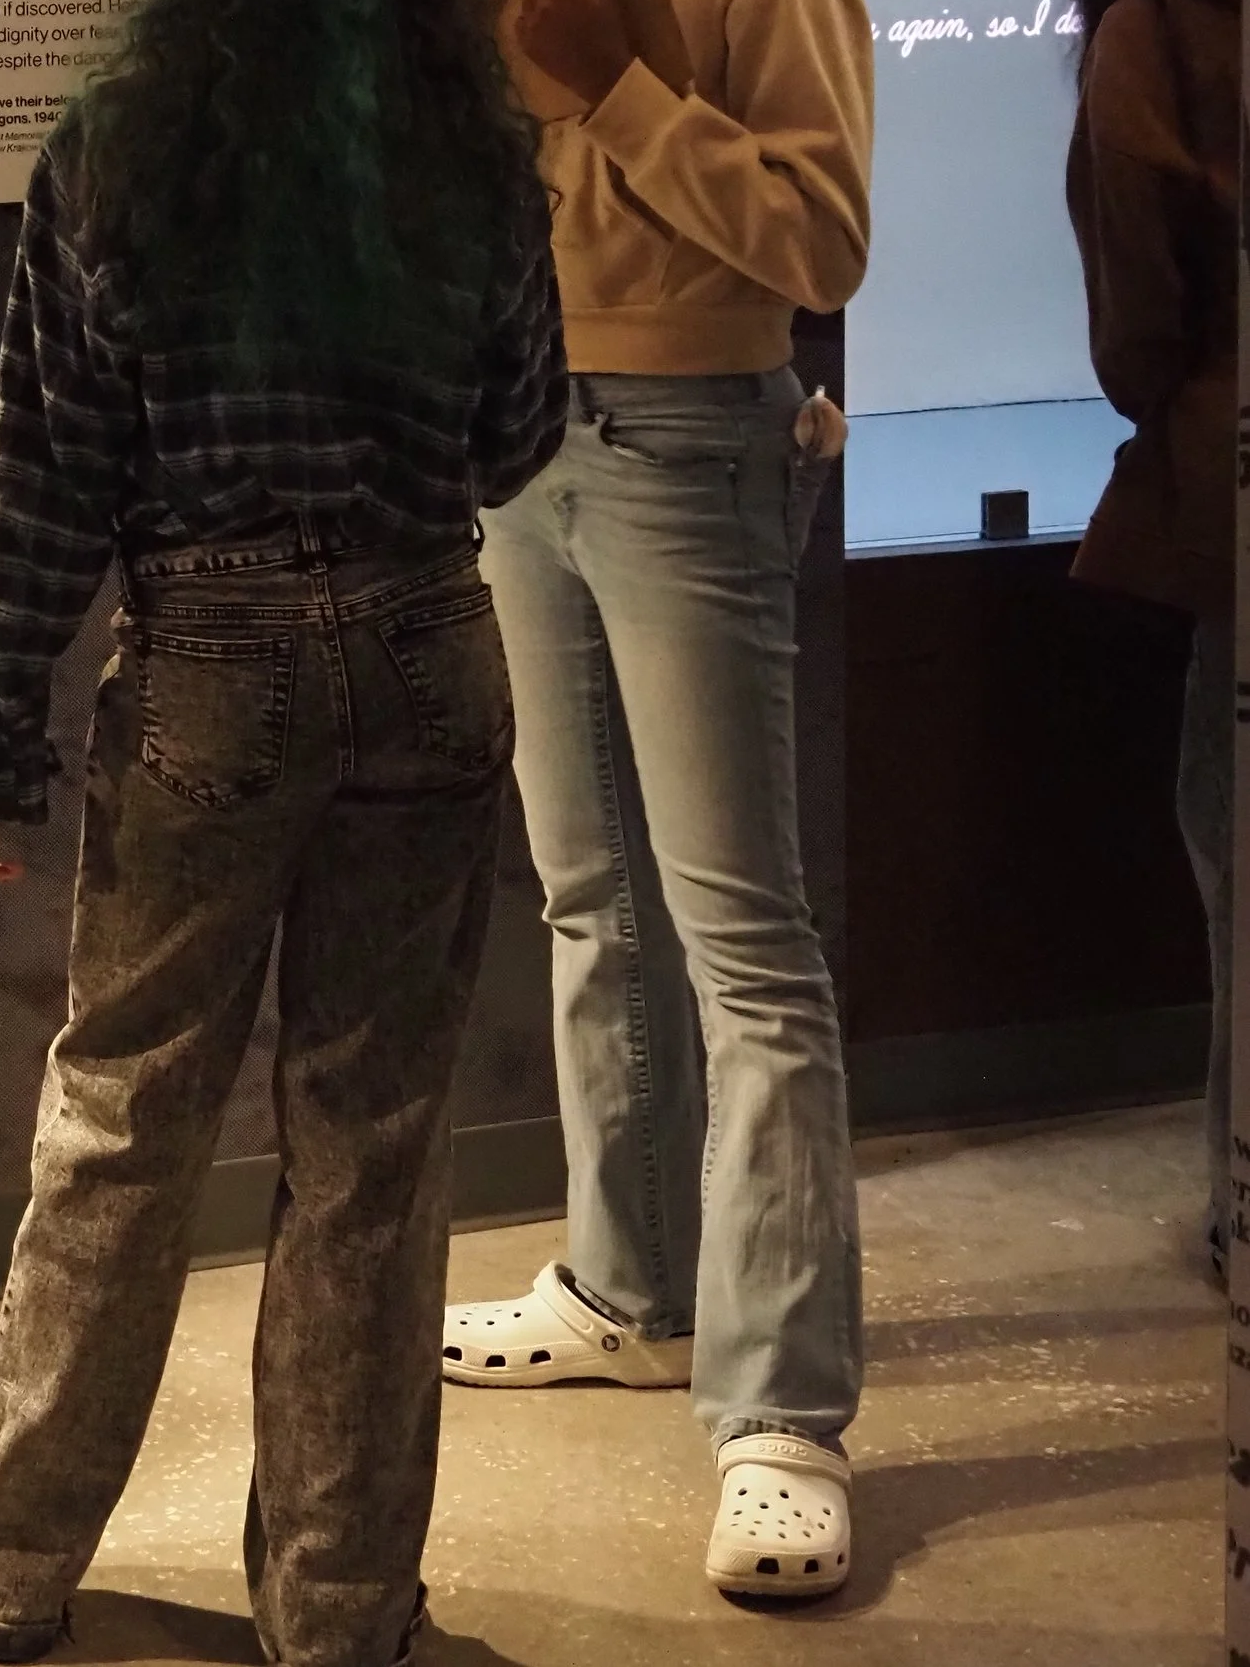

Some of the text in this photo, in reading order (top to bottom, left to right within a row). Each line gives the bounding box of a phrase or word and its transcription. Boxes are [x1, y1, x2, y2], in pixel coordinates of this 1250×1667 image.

[51, 27, 86, 42] over
[889, 9, 974, 57] again,
[46, 52, 70, 66] the
[15, 94, 43, 108] their
